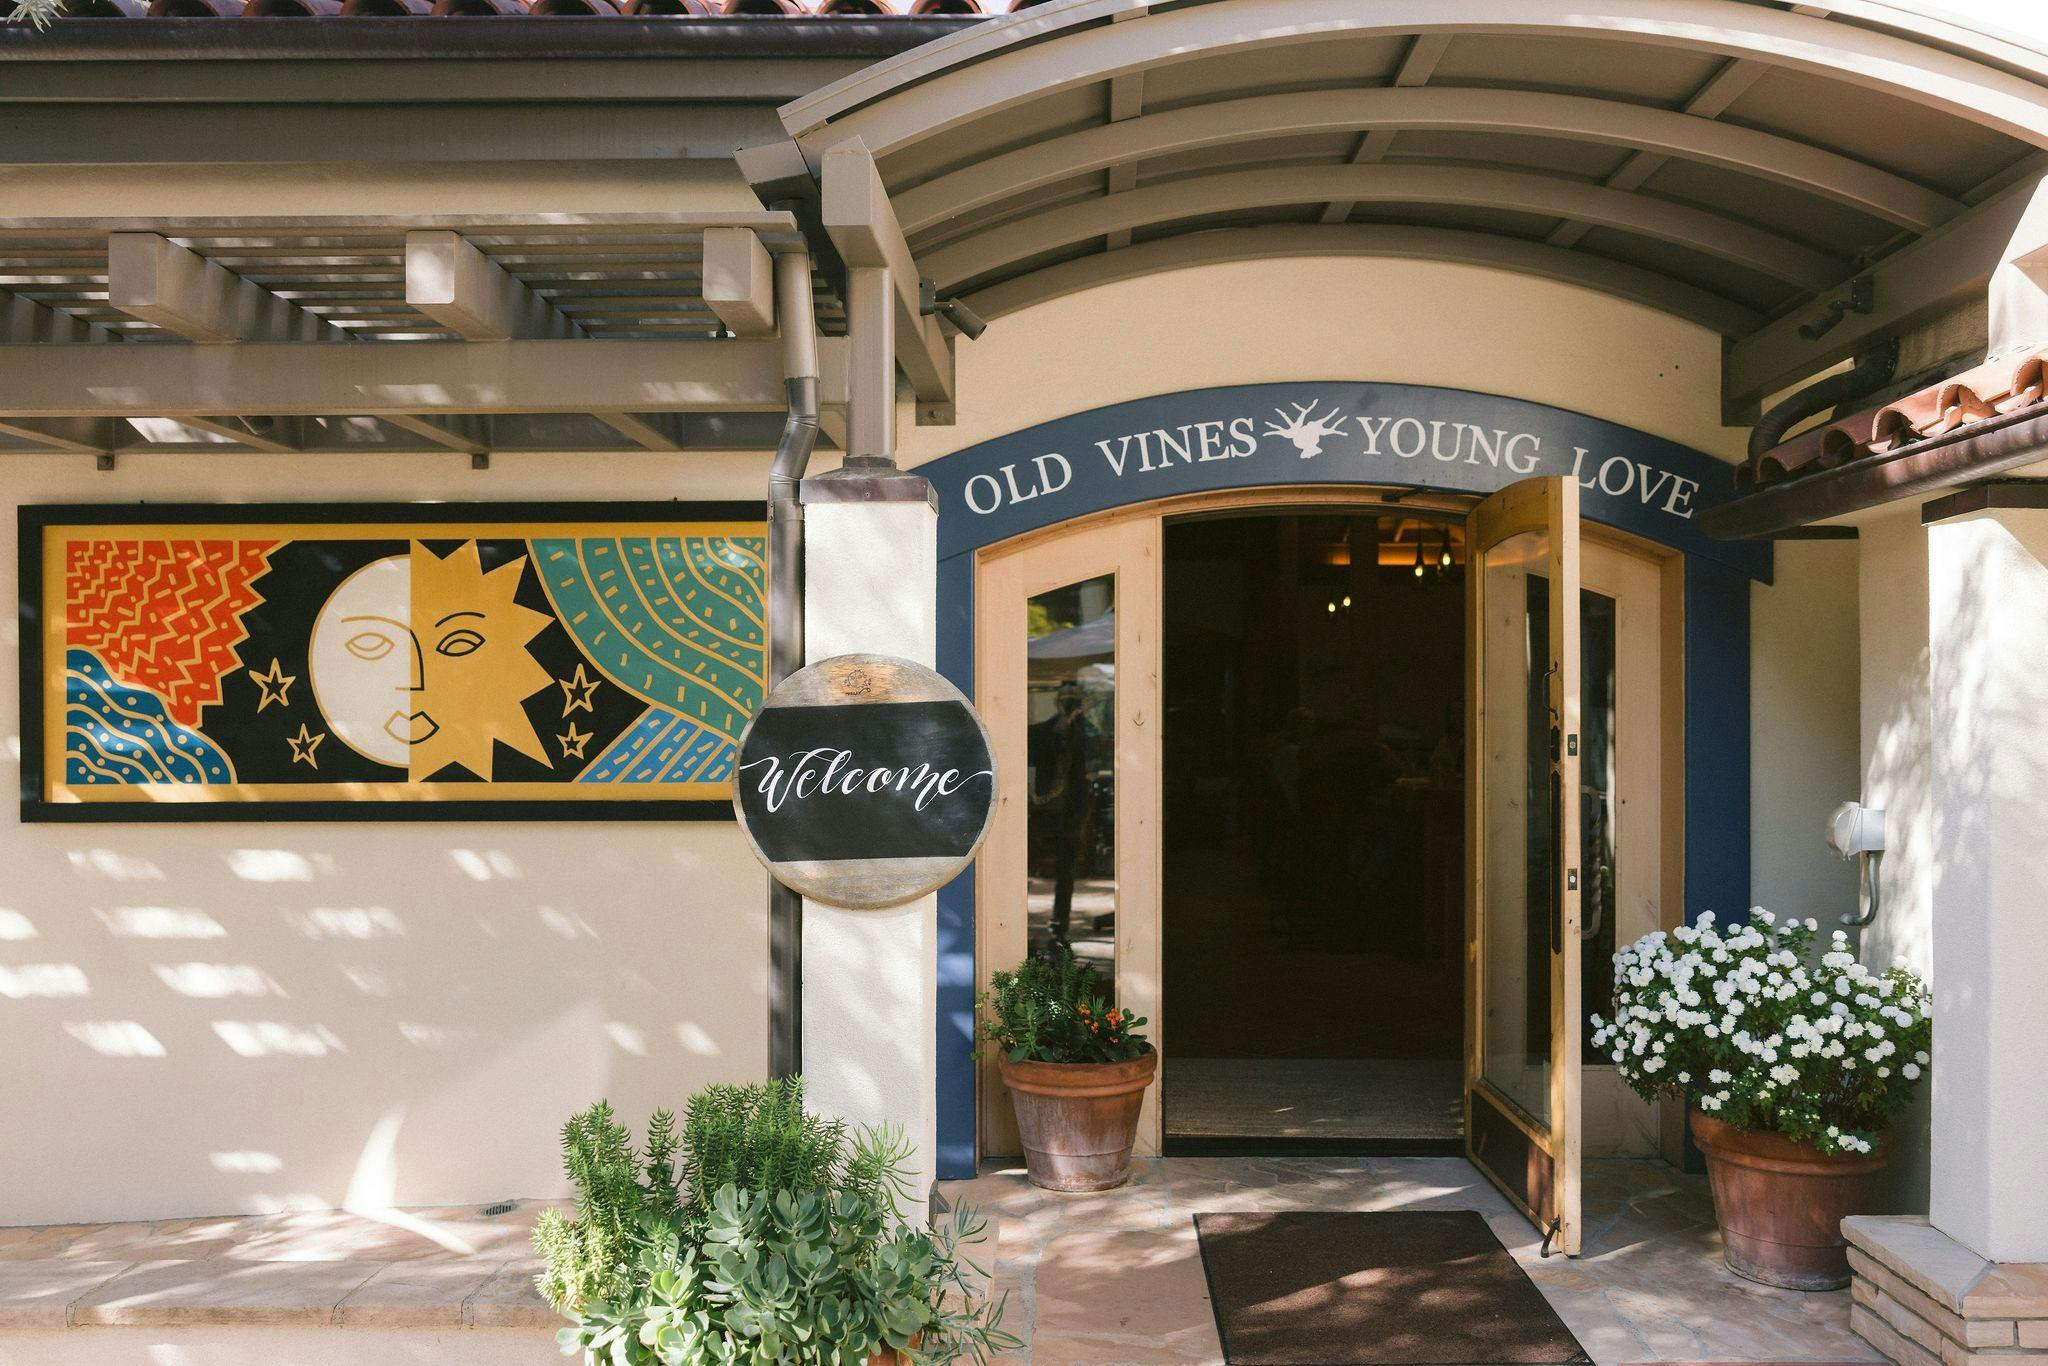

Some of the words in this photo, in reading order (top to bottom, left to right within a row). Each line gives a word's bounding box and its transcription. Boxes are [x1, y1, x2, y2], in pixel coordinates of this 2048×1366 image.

[964, 453, 1073, 515] OLD
[1095, 417, 1258, 477] VINES
[1356, 416, 1541, 474] YOUNG
[1571, 447, 1700, 519] LOVE
[740, 747, 993, 813] Welcome
